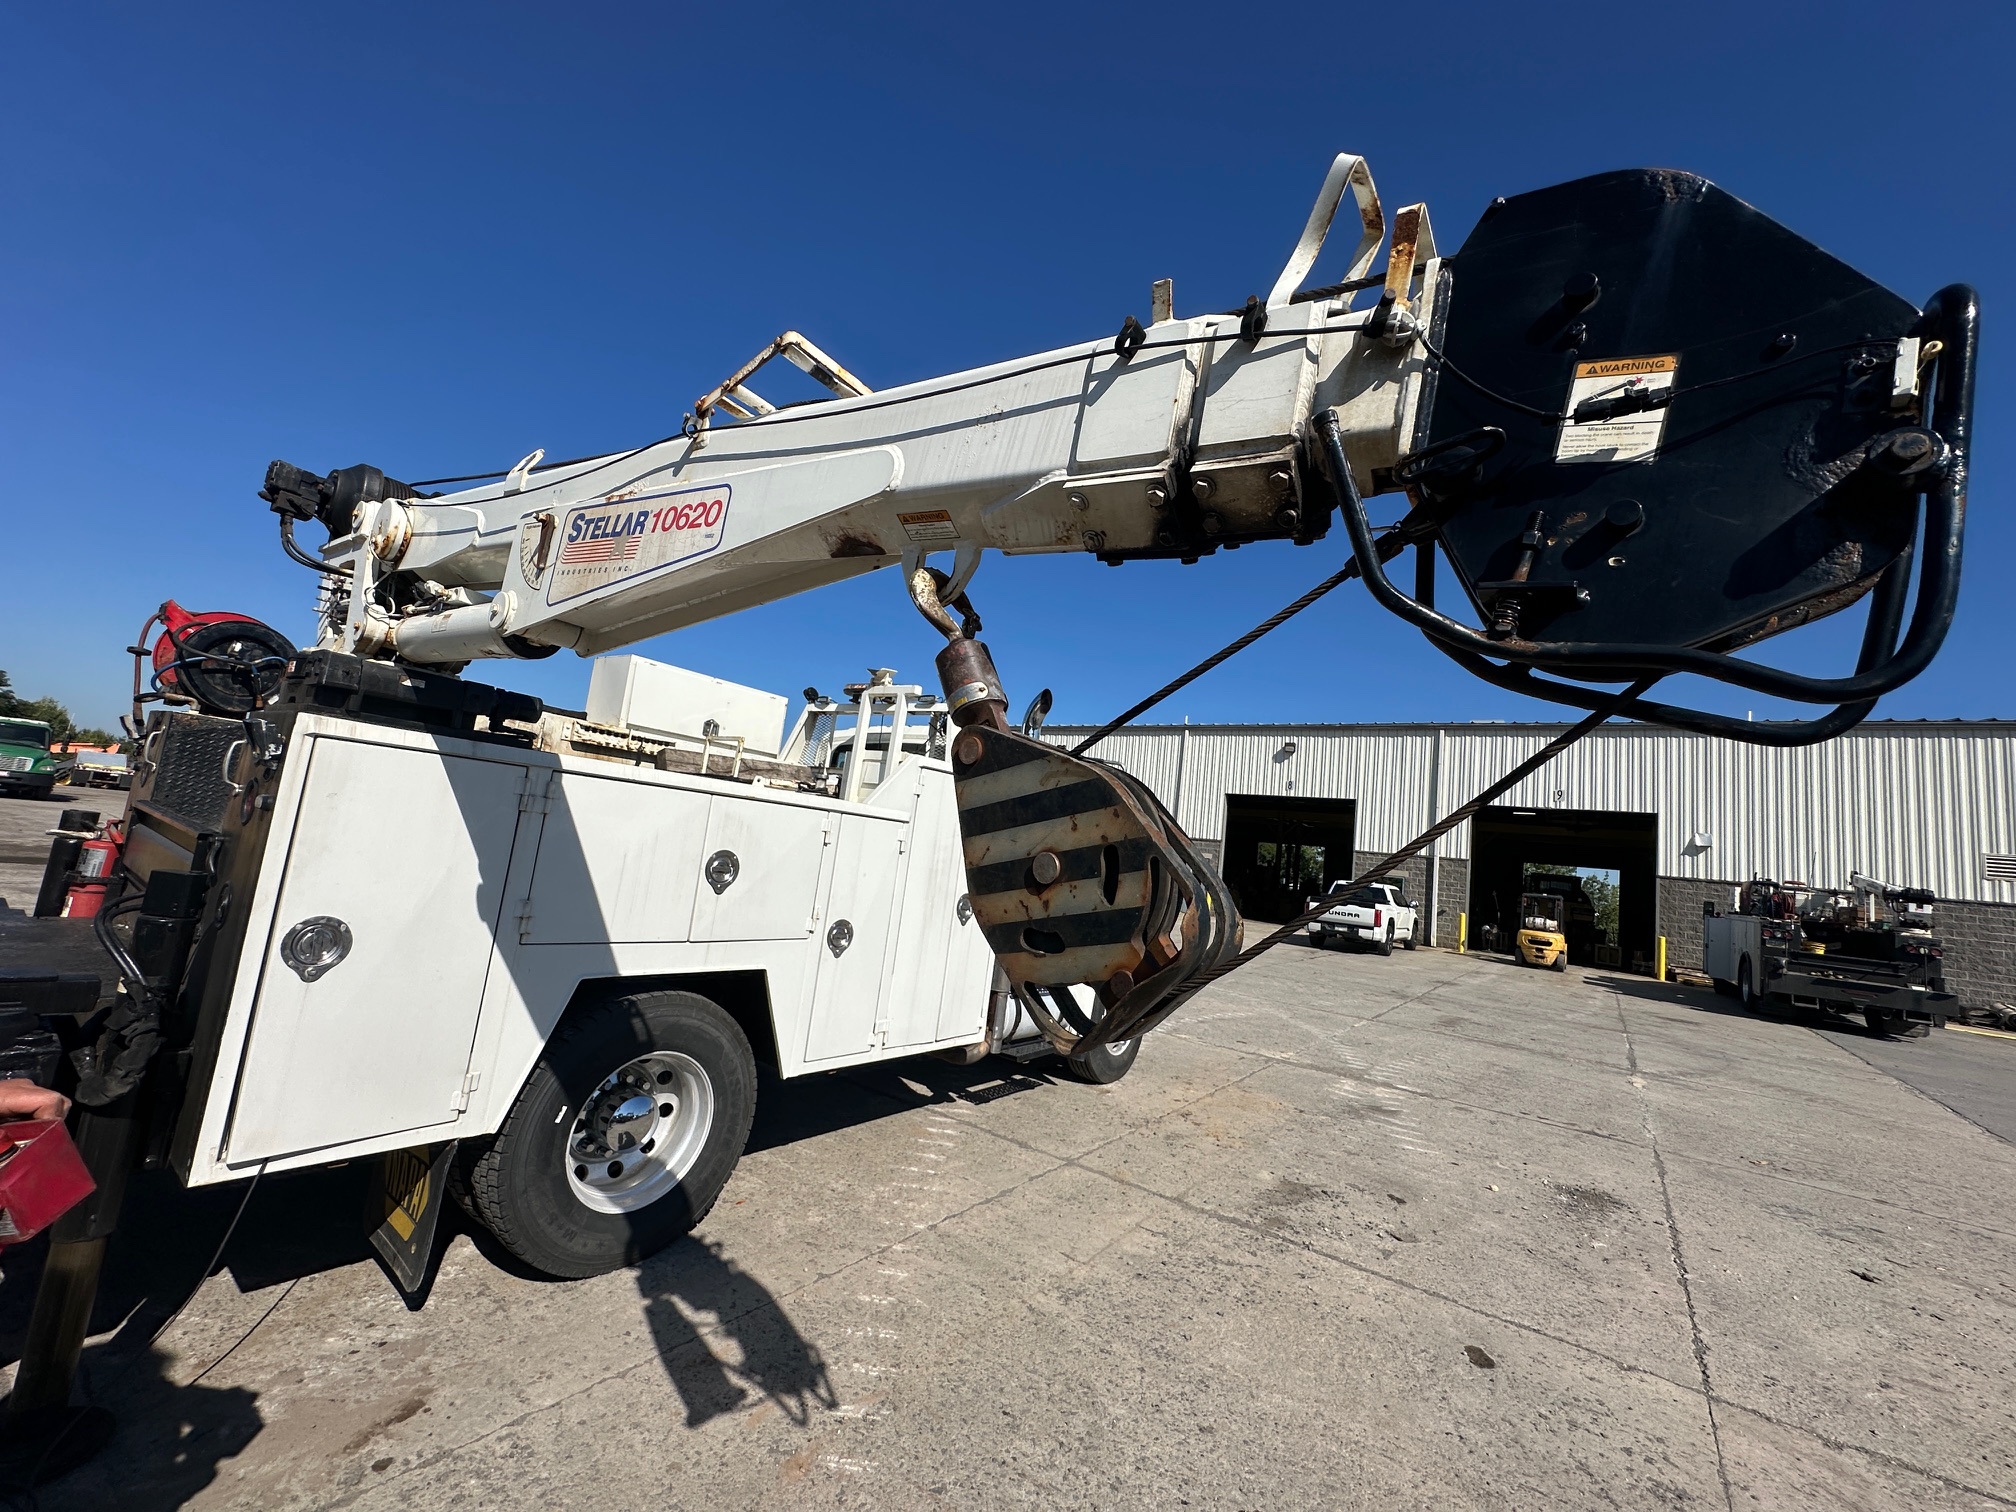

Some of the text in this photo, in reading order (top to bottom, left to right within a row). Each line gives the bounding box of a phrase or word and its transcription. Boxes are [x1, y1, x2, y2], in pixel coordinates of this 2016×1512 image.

[1600, 360, 1665, 373] WARNING
[567, 499, 723, 543] STELLAR 10620
[909, 512, 945, 521] WARNING
[557, 565, 632, 576] INDUSTRIES INC.
[1288, 780, 1292, 789] 8
[1557, 790, 1563, 800] 9
[1328, 910, 1360, 919] UNDRA
